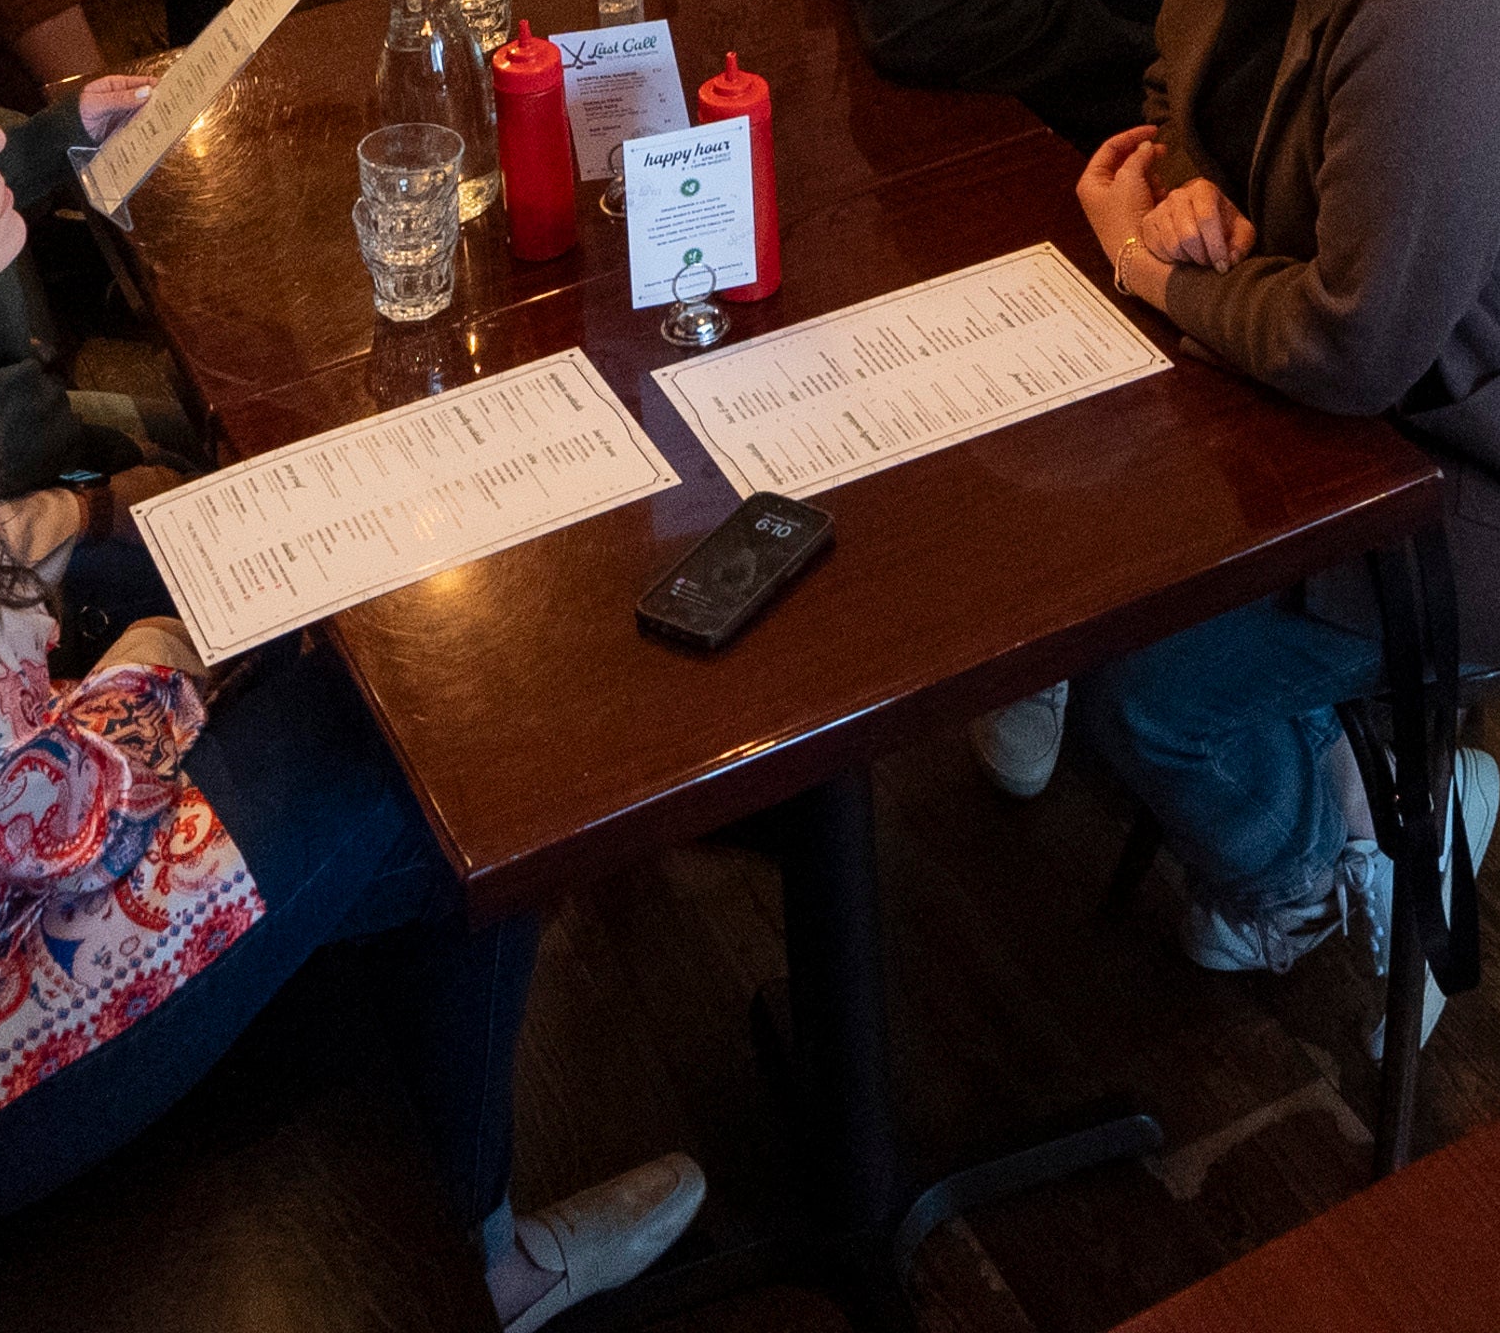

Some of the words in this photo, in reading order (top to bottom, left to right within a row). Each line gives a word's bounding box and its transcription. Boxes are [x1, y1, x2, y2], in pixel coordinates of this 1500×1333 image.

[587, 38, 619, 60] Last
[622, 35, 658, 54] Call
[643, 146, 693, 169] happy
[693, 140, 731, 159] hour
[755, 517, 793, 539] 6:10
